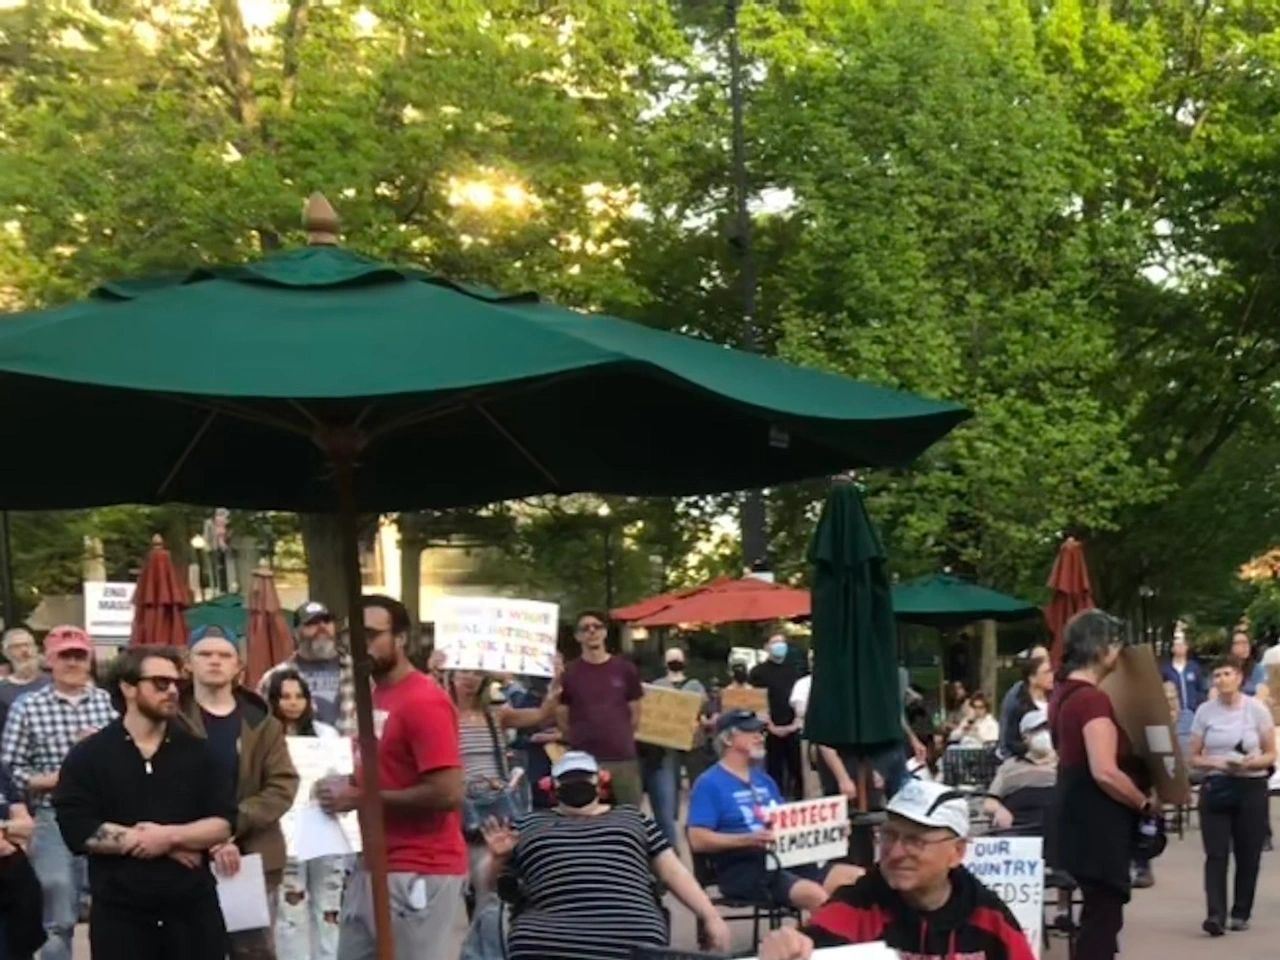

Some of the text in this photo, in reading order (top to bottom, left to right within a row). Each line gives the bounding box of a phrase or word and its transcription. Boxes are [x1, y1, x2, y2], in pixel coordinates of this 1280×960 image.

[769, 802, 839, 829] PROTECT
[975, 840, 1011, 857] OUR
[968, 860, 1038, 876] OUNTRY
